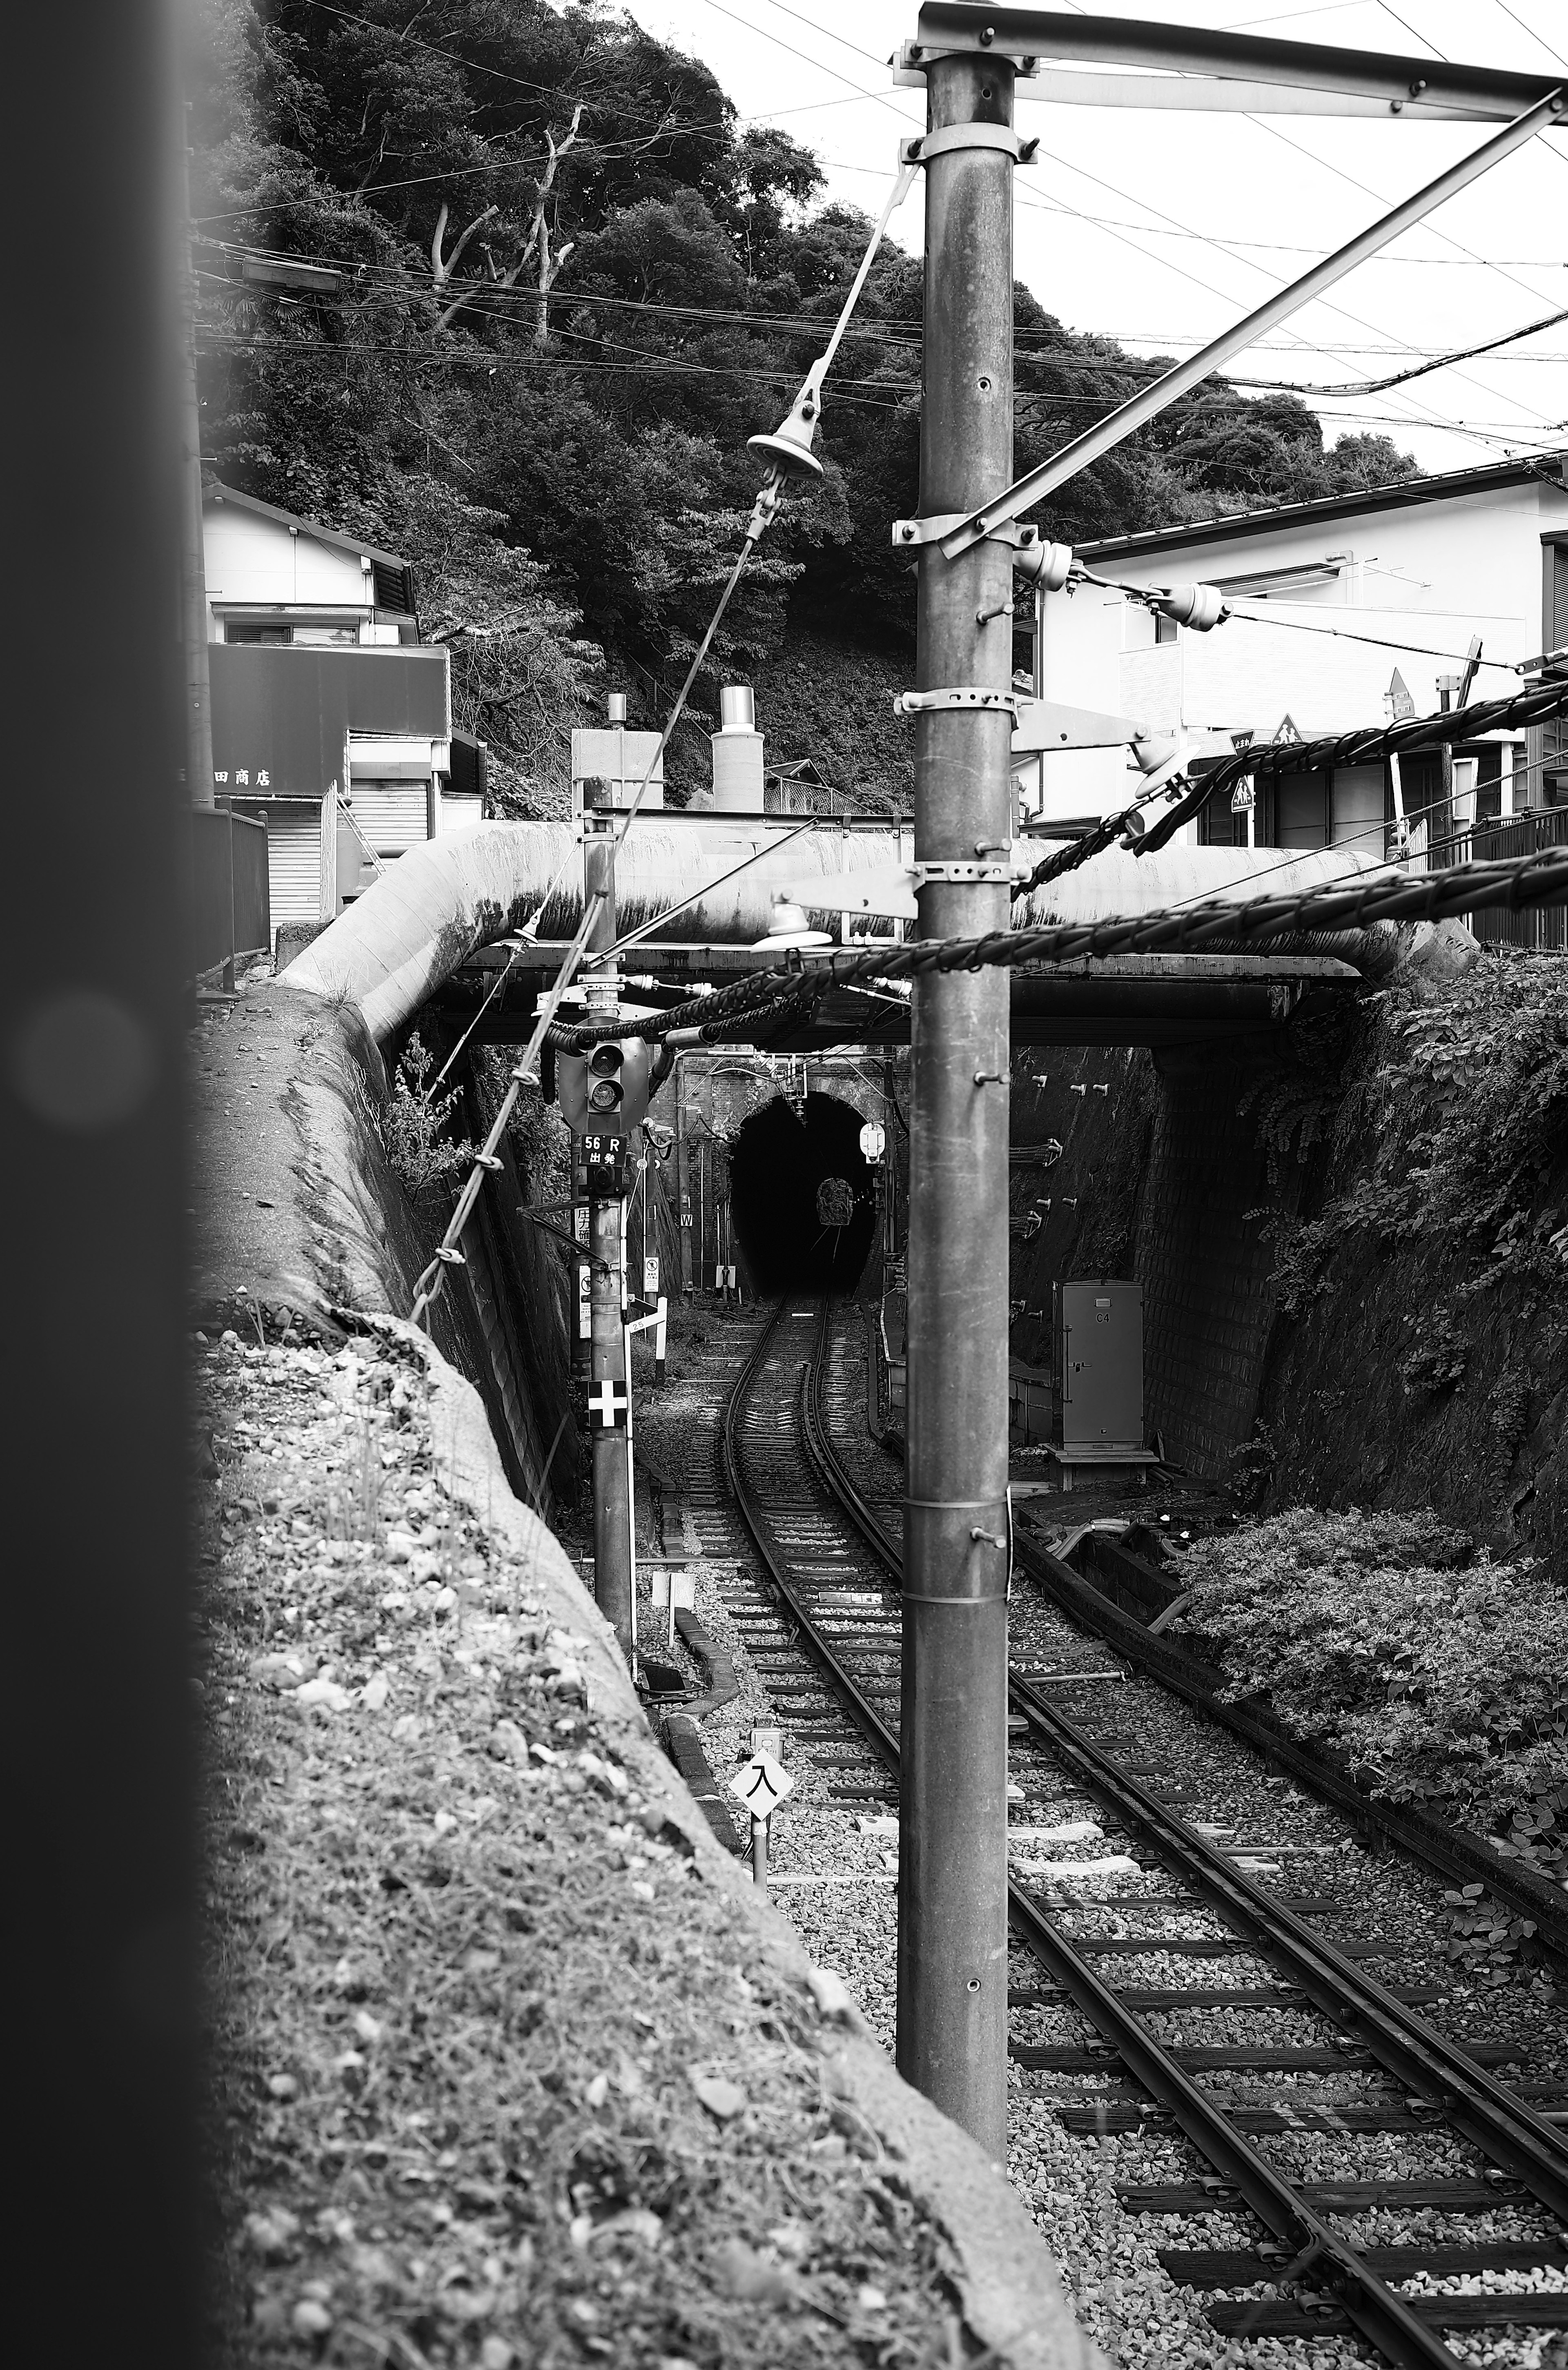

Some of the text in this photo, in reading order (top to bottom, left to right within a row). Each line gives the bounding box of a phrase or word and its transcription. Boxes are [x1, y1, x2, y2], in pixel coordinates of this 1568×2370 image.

[1235, 738, 1250, 749] 止まれ
[585, 1136, 619, 1152] 56 R
[590, 1152, 615, 1165] 出発
[682, 1215, 692, 1225] W
[1097, 1313, 1109, 1323] C4
[633, 1321, 644, 1330] 25
[746, 1765, 778, 1798] 入
